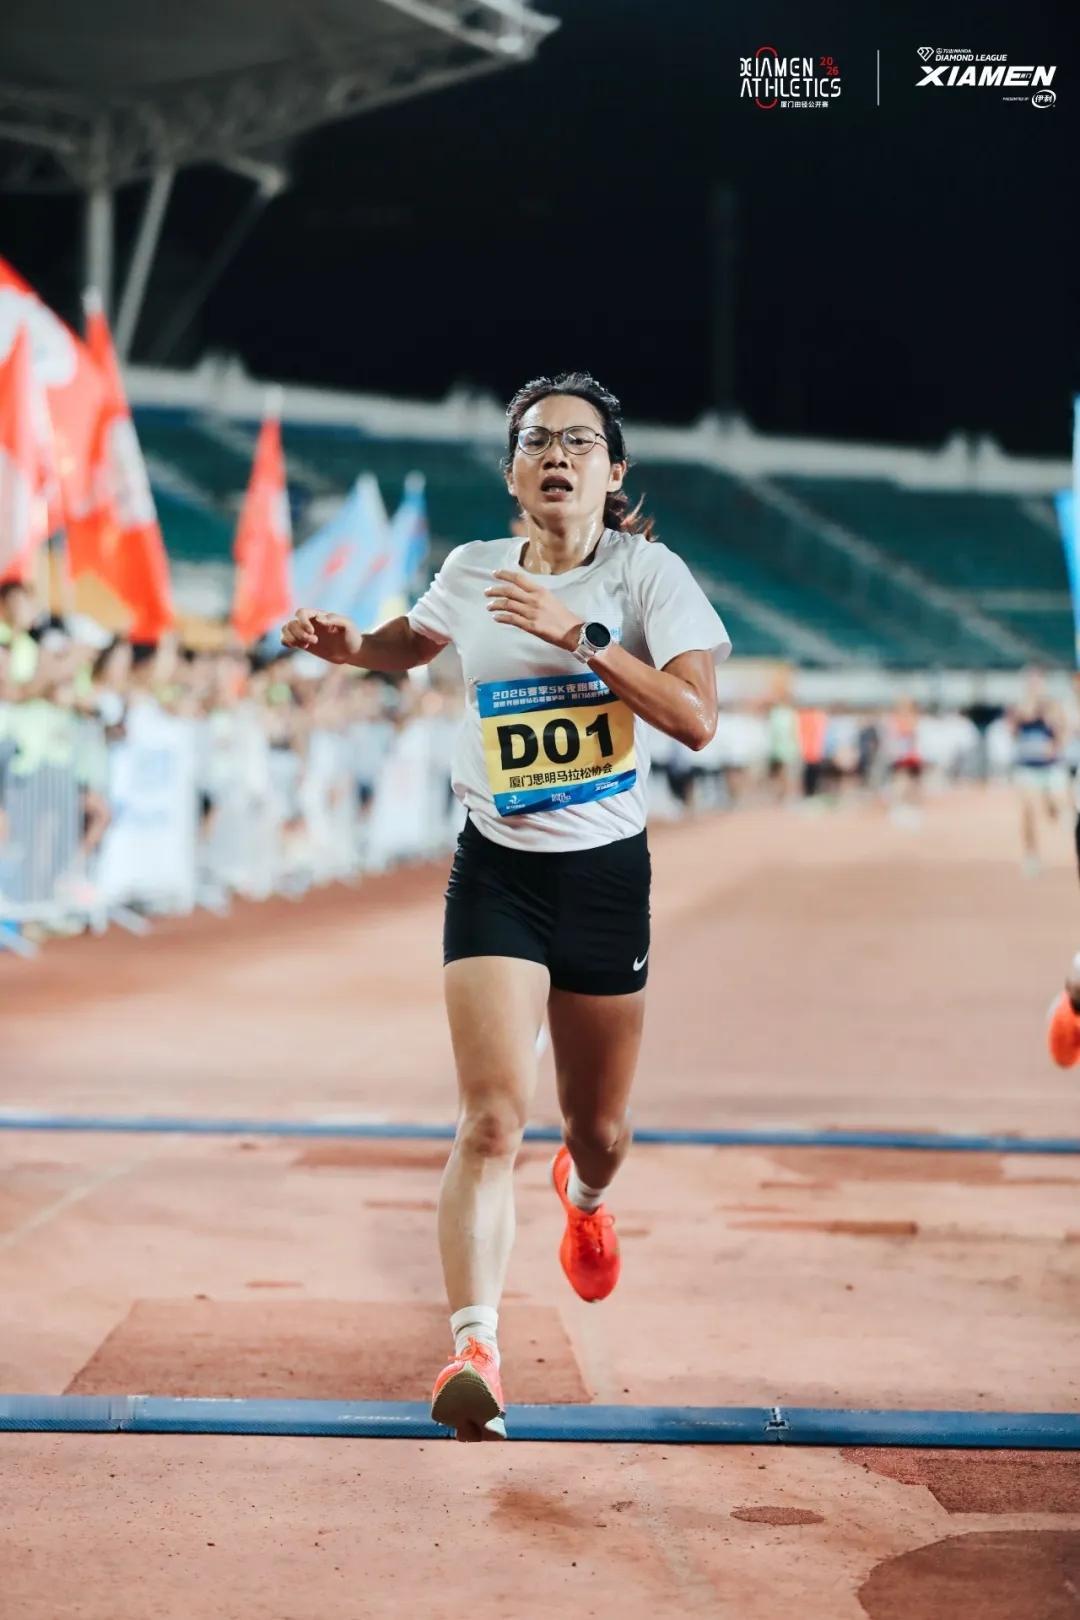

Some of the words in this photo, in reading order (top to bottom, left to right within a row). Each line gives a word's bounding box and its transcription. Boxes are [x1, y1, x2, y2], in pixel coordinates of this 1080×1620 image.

[496, 712, 614, 771] D01
[509, 763, 613, 789] 厦门思明马拉松协会
